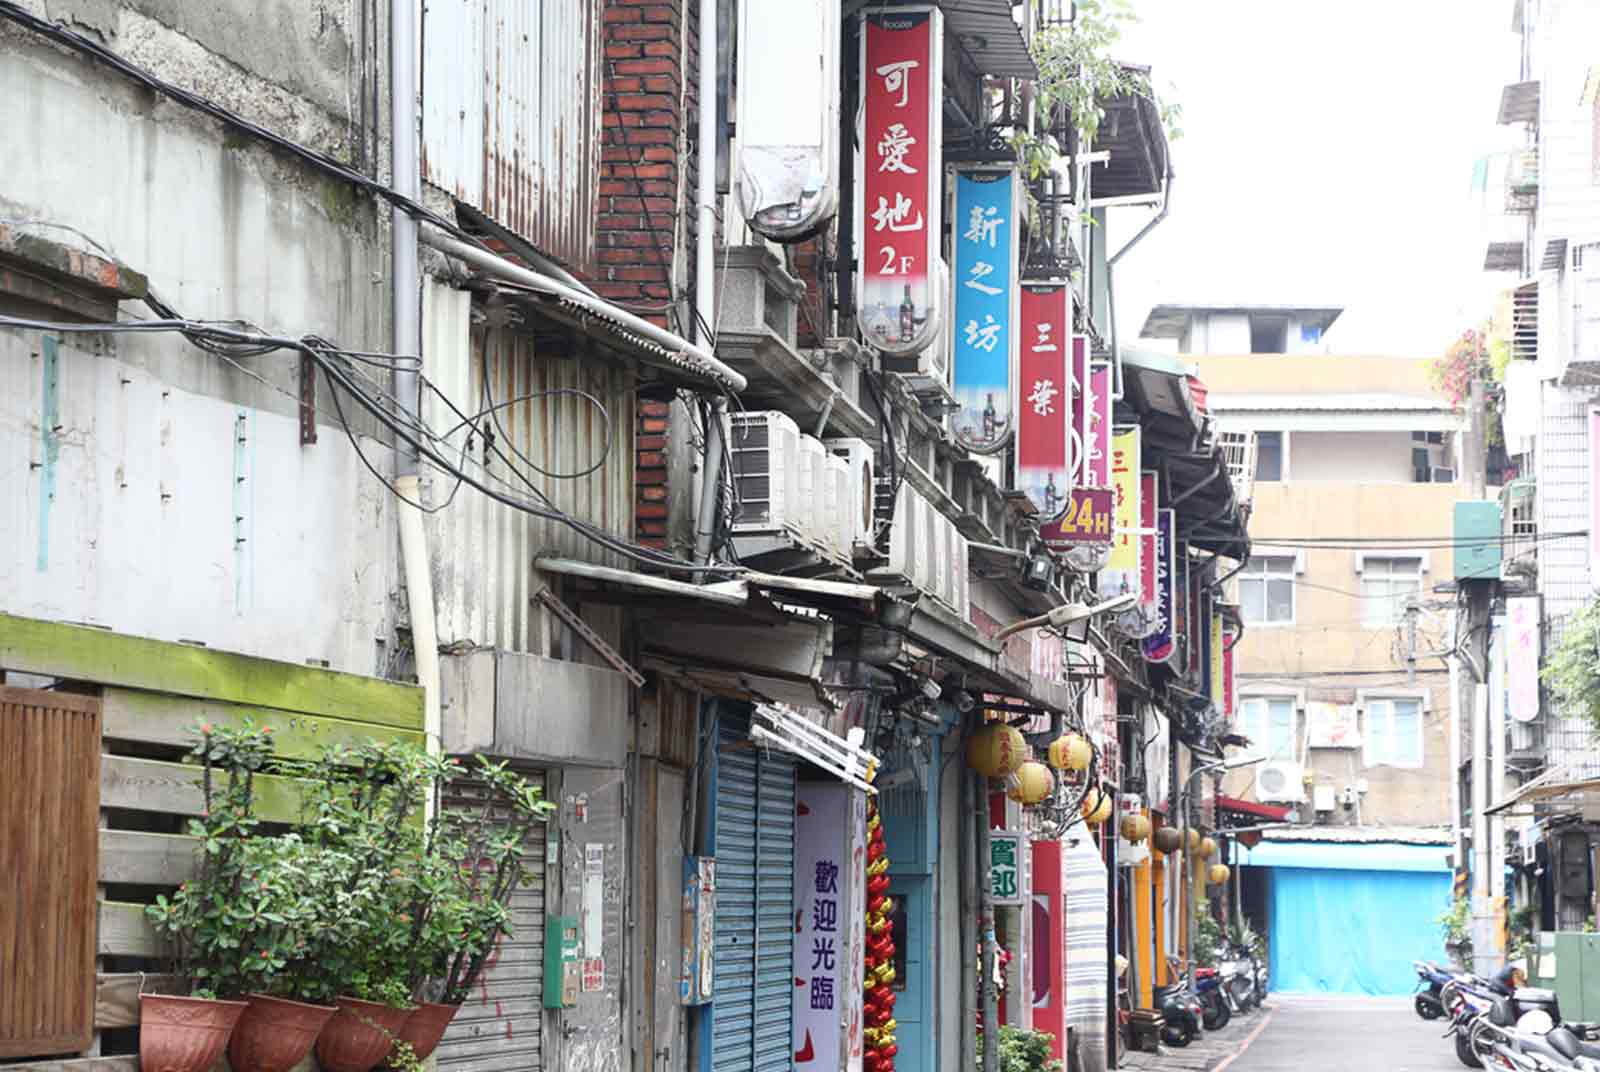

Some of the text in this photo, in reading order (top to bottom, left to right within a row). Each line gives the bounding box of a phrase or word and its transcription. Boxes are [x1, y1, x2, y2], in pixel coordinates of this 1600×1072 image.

[871, 59, 923, 232] 可愛地
[879, 245, 915, 275] 2F
[963, 204, 1005, 353] 新之坊
[1060, 497, 1110, 535] 24H
[810, 860, 840, 1011] 歡迎光臨
